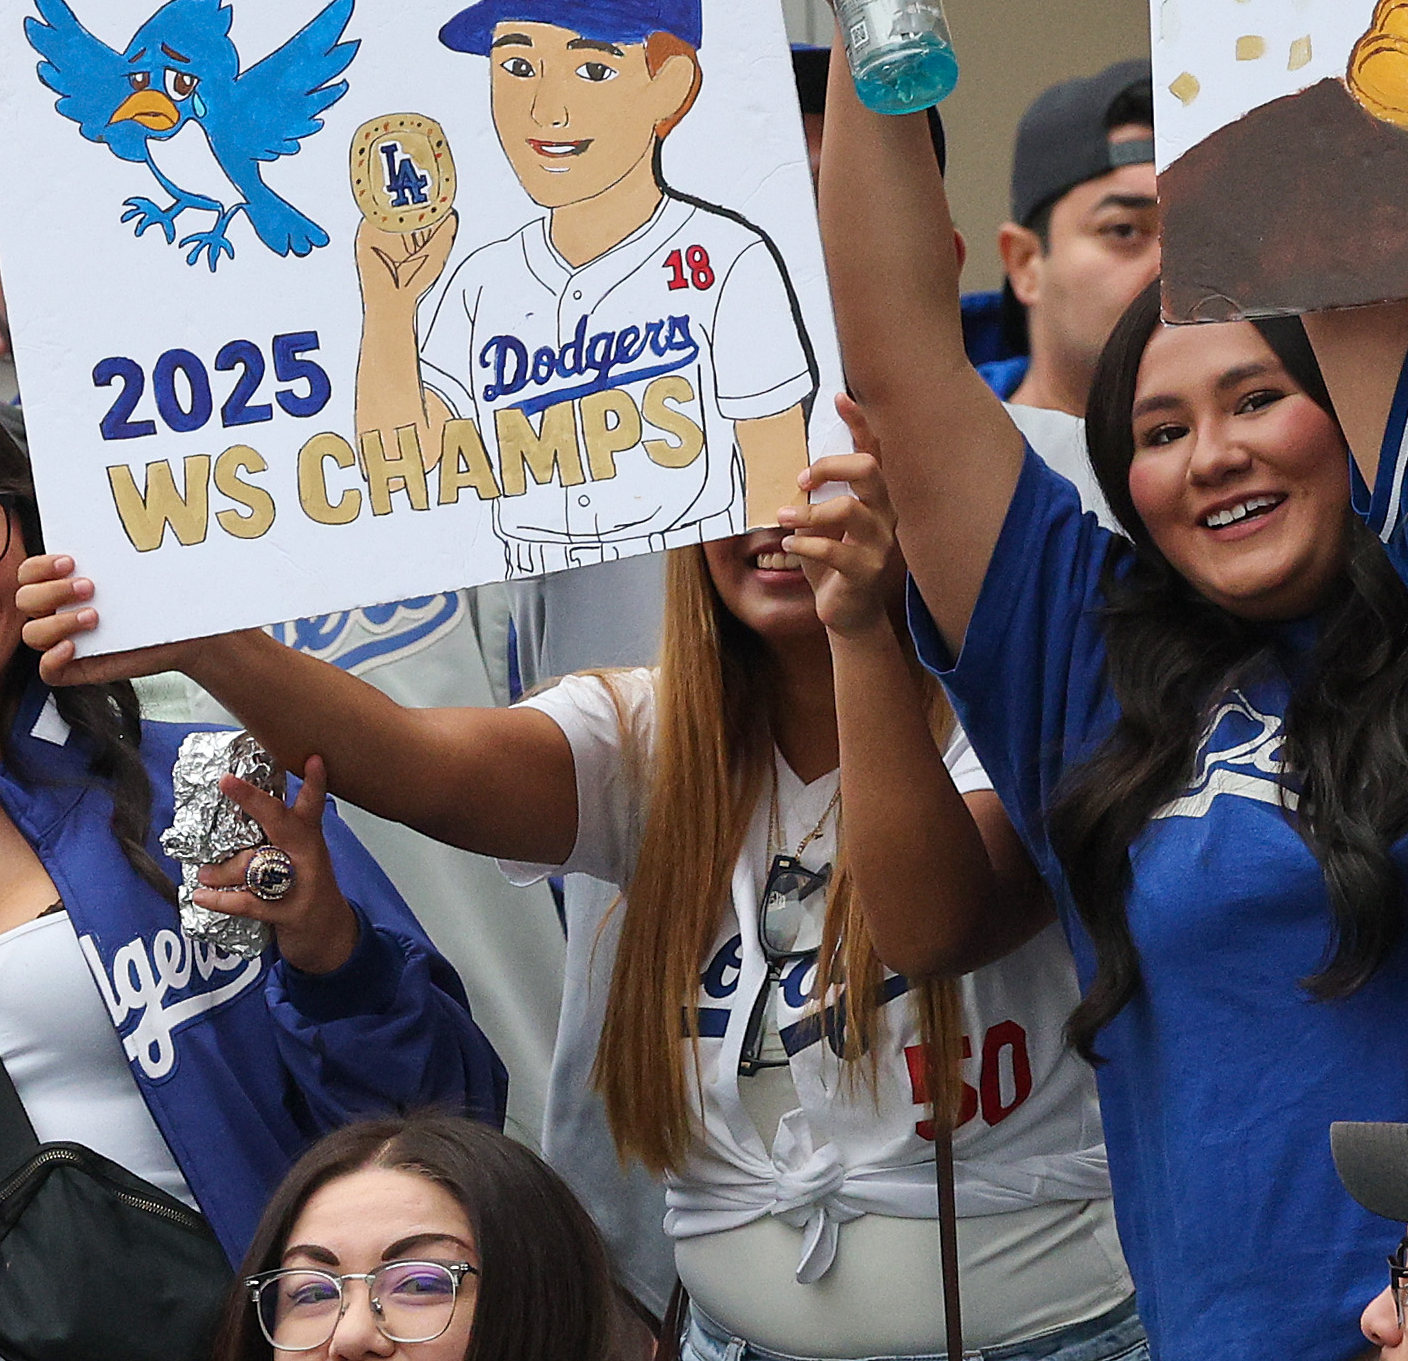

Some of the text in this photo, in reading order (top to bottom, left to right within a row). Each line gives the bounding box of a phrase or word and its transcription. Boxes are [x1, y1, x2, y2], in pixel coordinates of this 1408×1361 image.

[379, 142, 427, 207] LA
[663, 243, 715, 291] 18
[92, 330, 332, 441] 2025
[480, 313, 699, 412] Dodgers
[107, 376, 704, 553] WS CHAMPS
